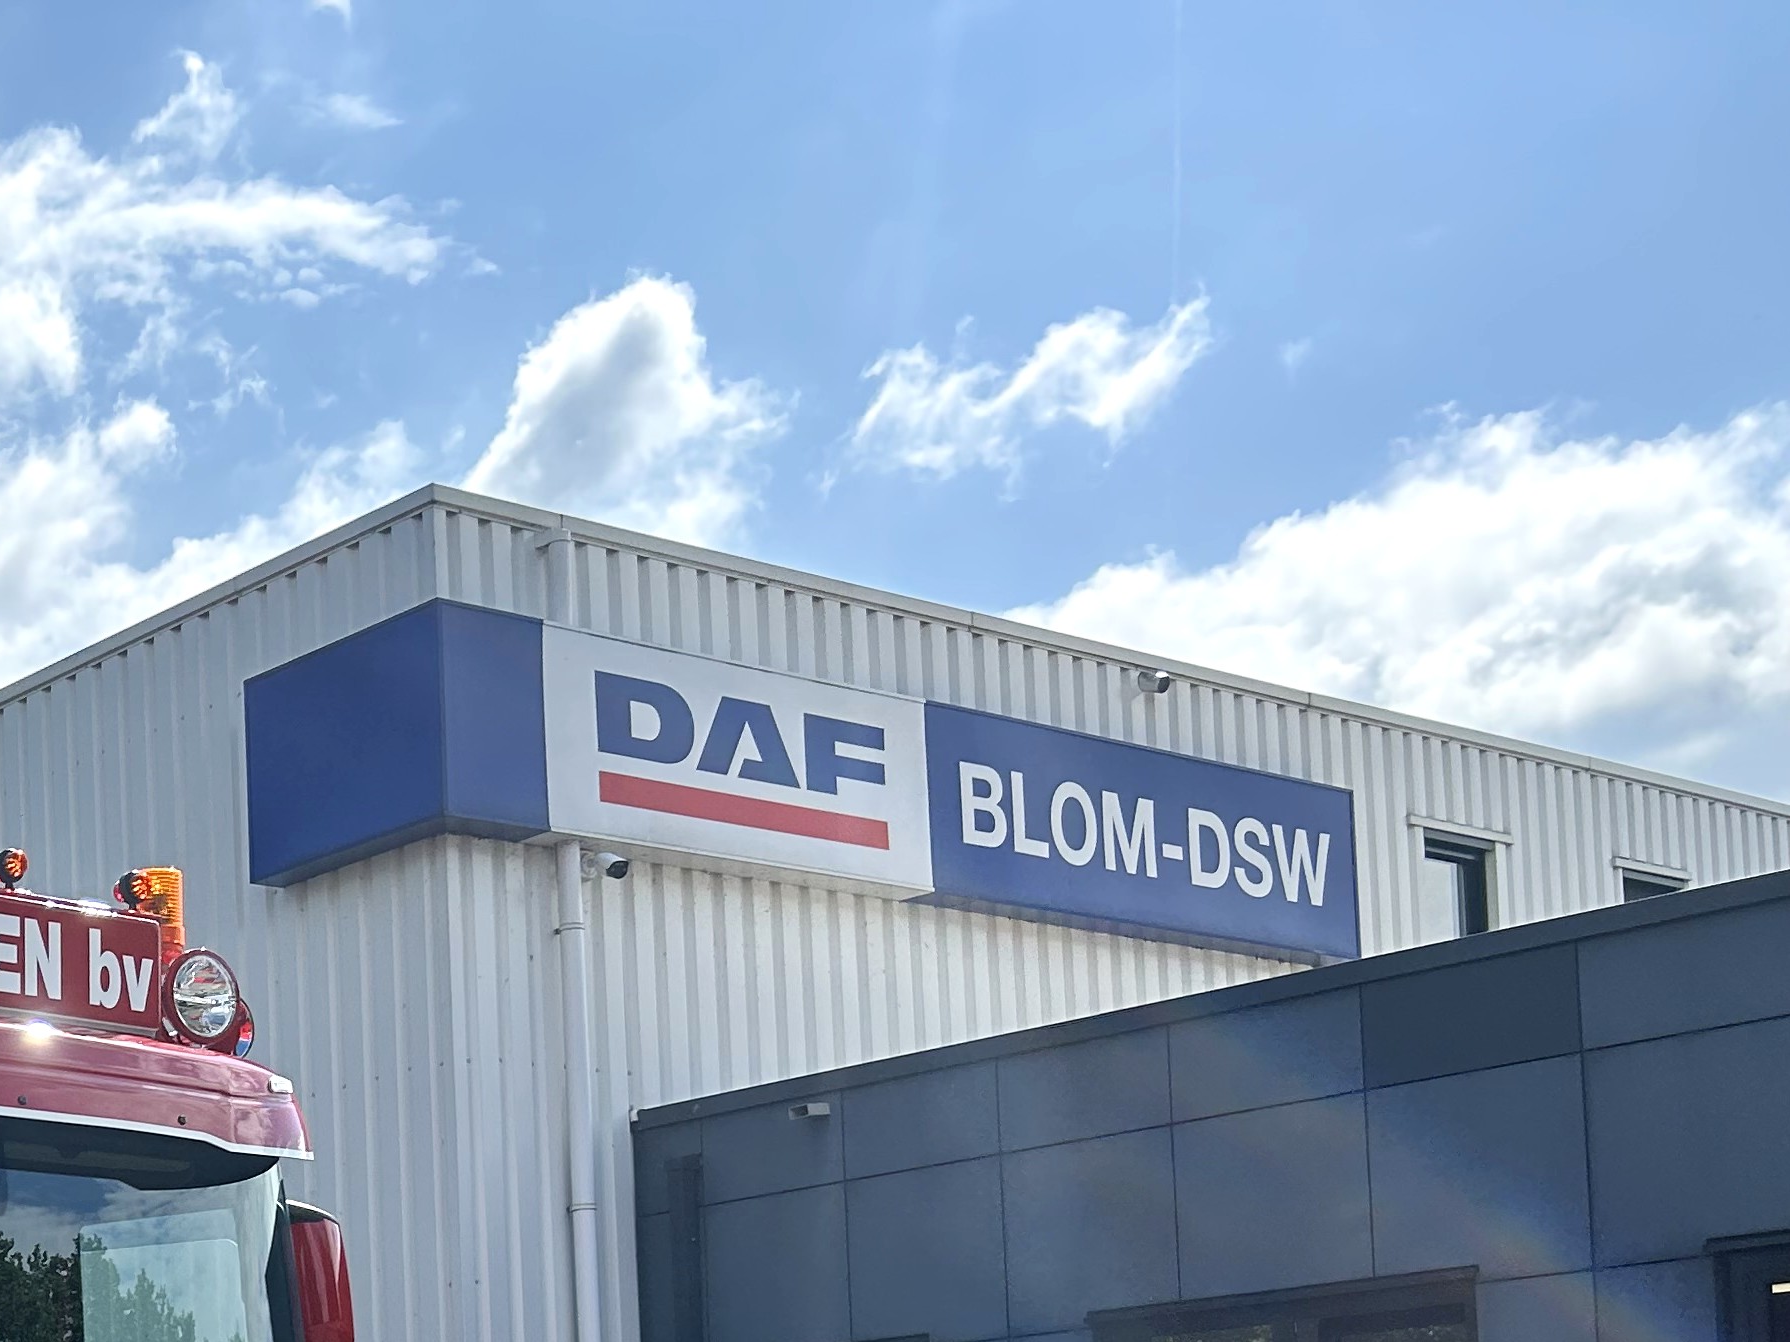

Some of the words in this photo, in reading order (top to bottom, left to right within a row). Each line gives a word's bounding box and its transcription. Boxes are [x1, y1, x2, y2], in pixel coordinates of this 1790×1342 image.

[593, 669, 886, 796] DAF
[958, 760, 1331, 907] BLOM-DSW
[88, 928, 154, 1013] bv
